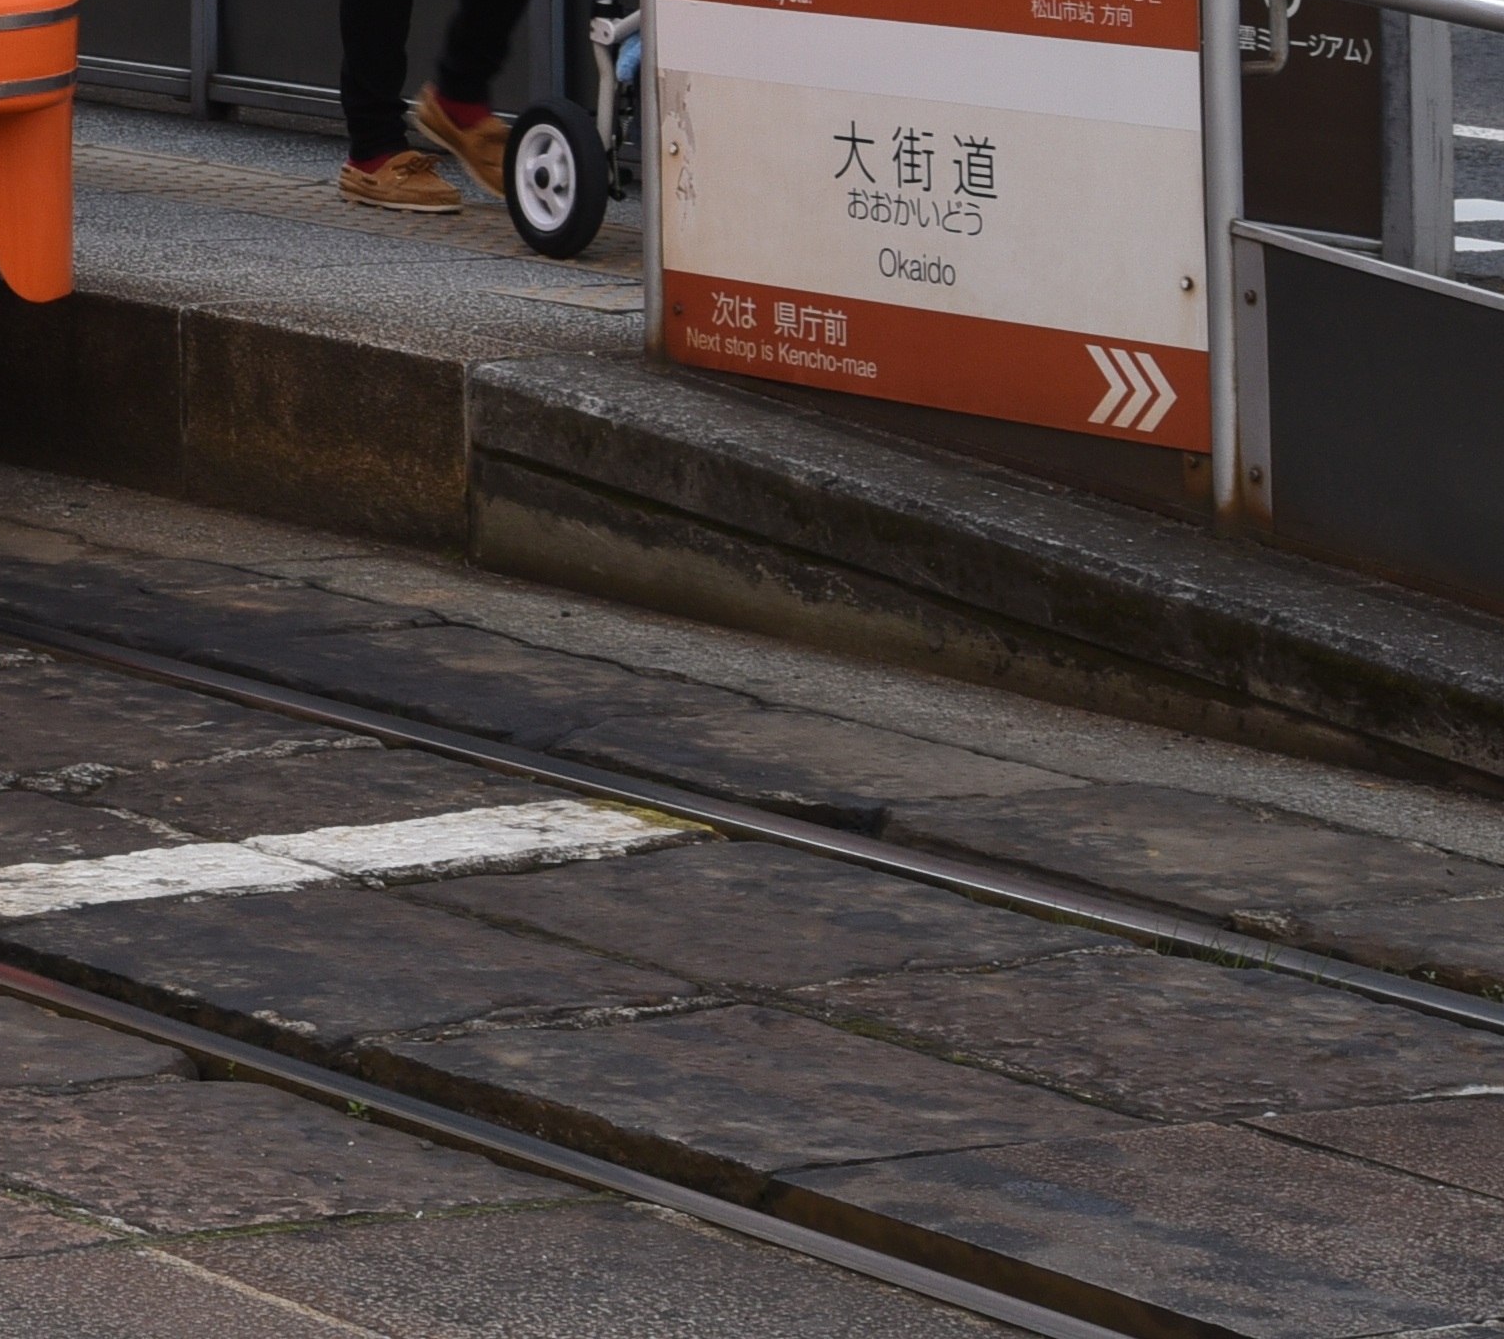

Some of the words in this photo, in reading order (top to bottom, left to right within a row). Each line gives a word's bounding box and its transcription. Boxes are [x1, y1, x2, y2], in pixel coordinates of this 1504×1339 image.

[1100, 4, 1133, 28] 方向
[834, 120, 997, 199] 大街道
[847, 187, 983, 237] おおかいどう
[878, 247, 957, 287] Okaido
[711, 291, 758, 329] 次は
[774, 301, 848, 347] 県庁前
[686, 326, 721, 353] Next
[724, 333, 757, 363] stop
[760, 339, 774, 362] is
[778, 342, 877, 379] Kencho-mae
